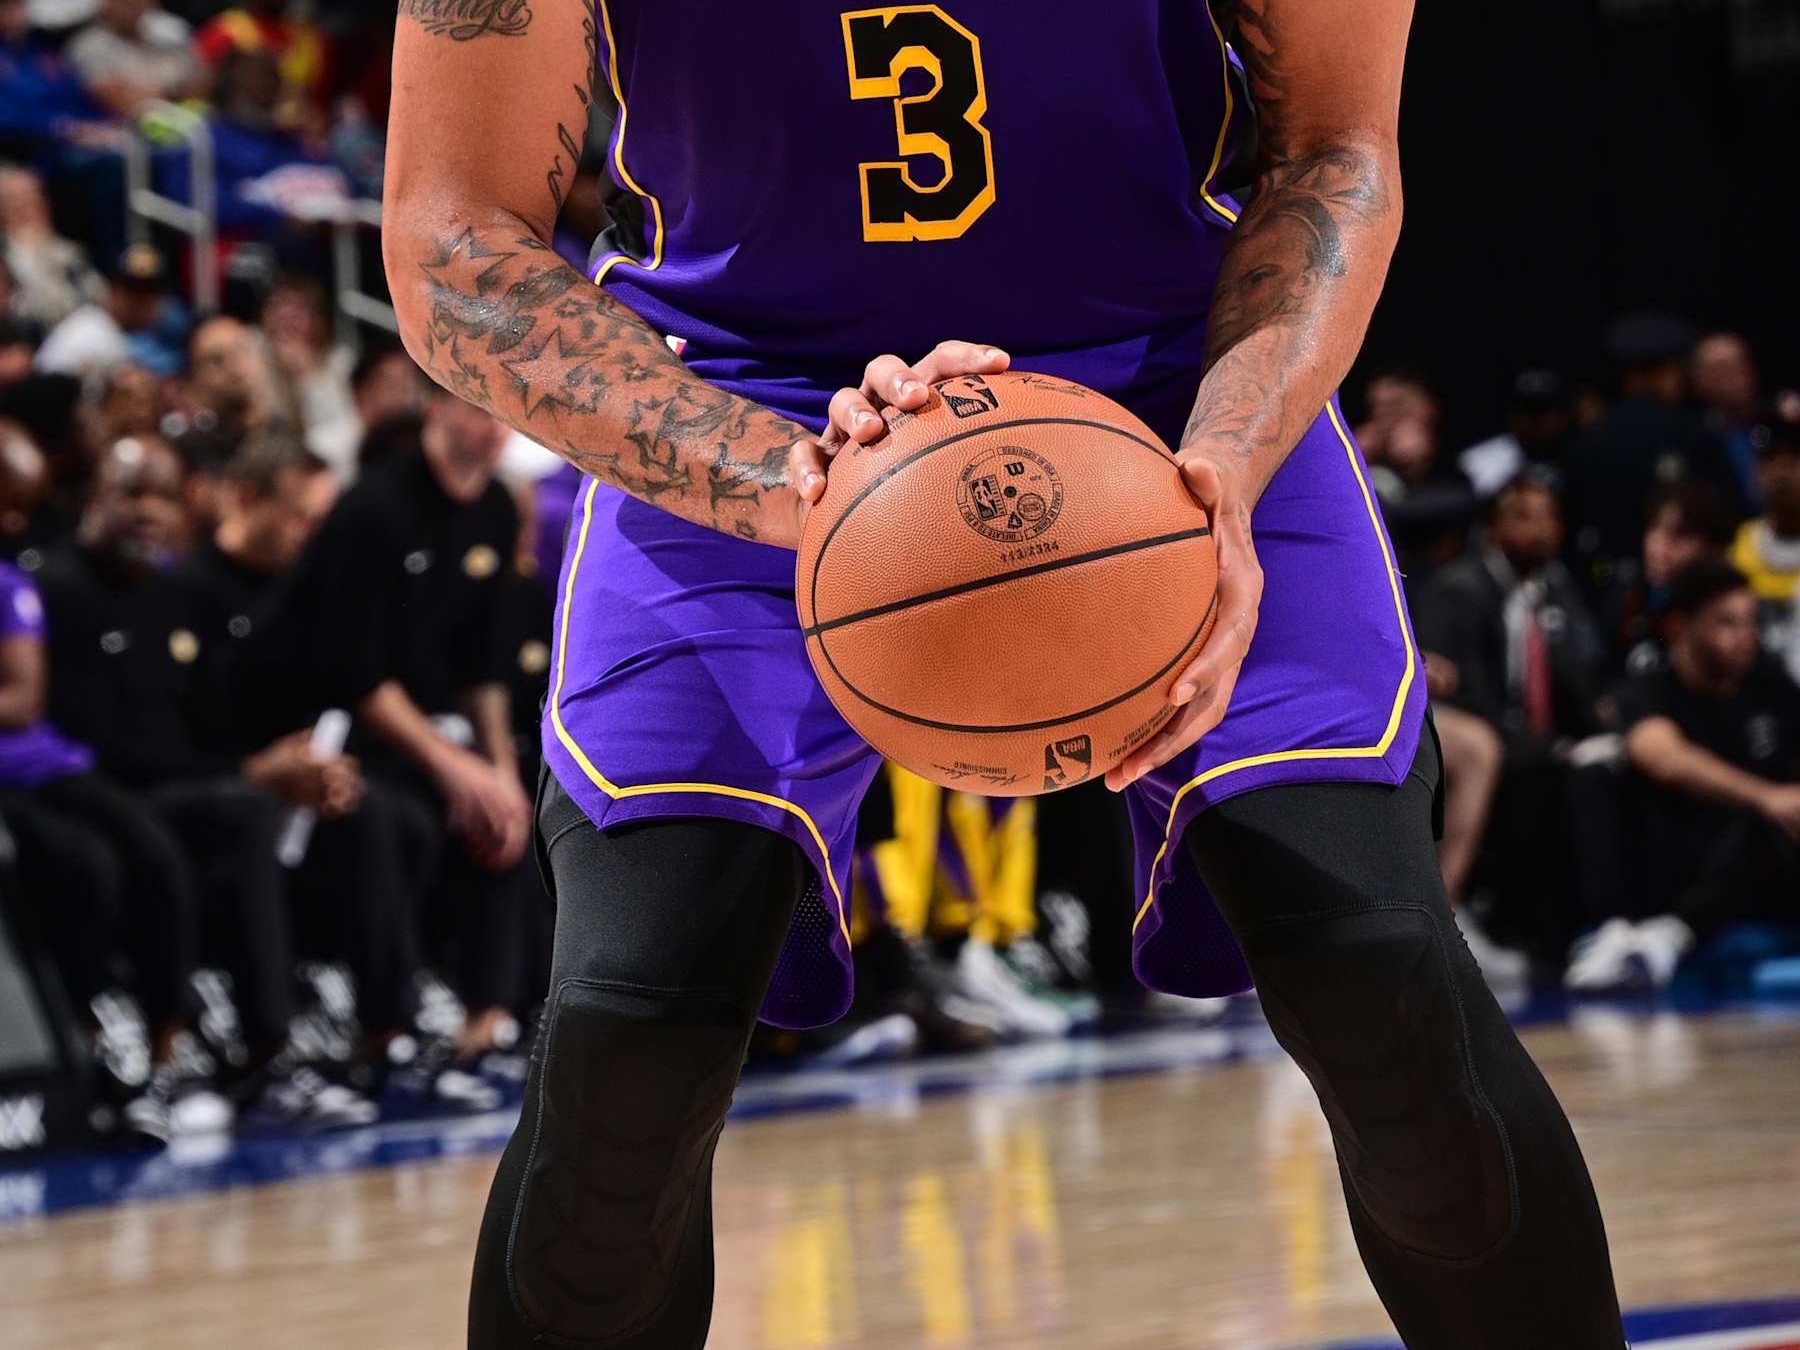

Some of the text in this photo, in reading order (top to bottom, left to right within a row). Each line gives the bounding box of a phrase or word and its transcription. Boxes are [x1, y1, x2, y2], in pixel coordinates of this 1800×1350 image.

[840, 3, 997, 243] 3
[956, 400, 983, 416] NBA
[1062, 737, 1087, 754] NBA
[953, 761, 1008, 776] COMMISSIONER
